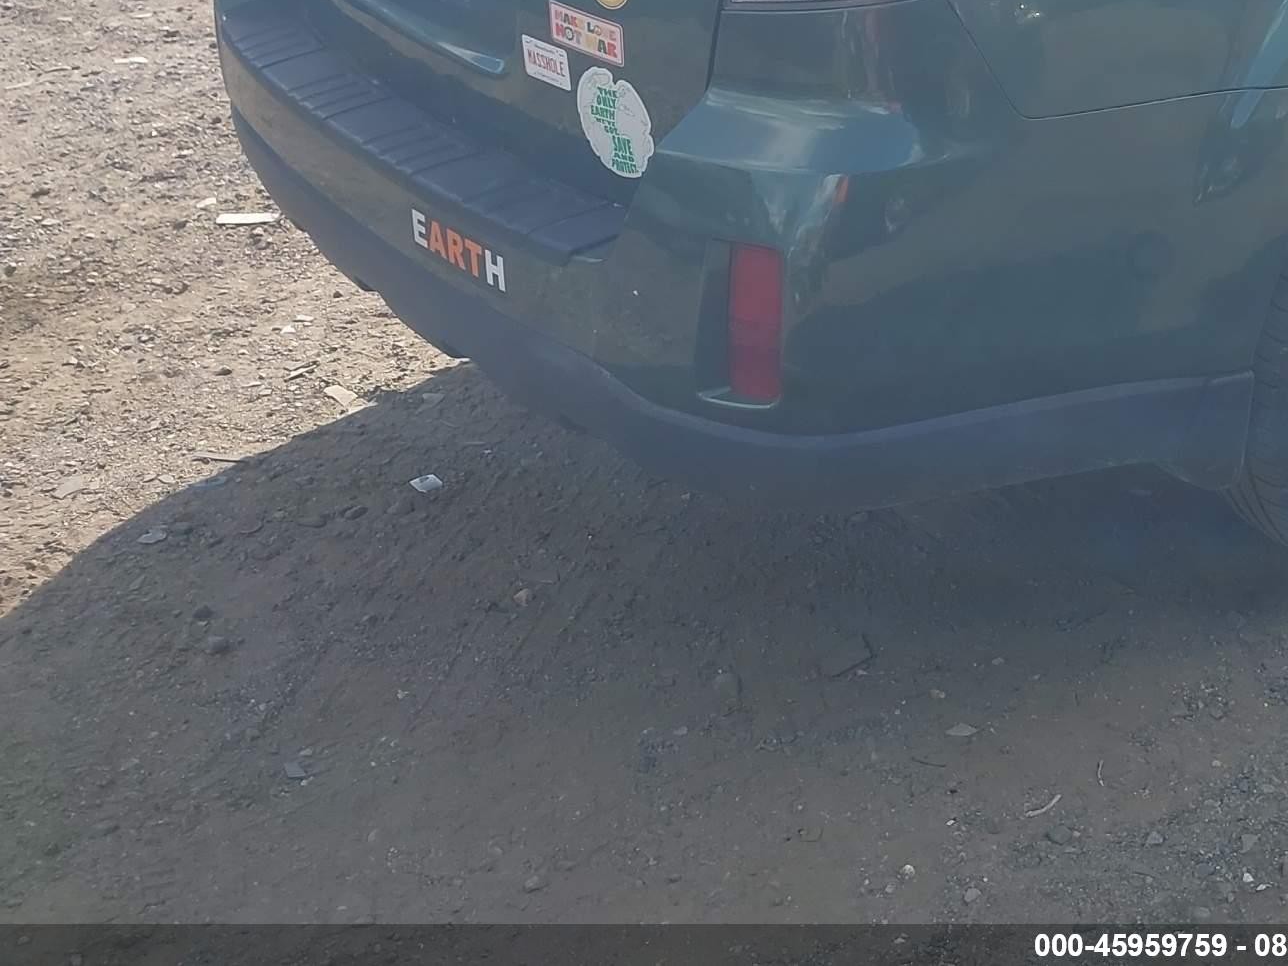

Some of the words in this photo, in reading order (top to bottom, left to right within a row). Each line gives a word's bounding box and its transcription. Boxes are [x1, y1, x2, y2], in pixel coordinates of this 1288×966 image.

[554, 9, 584, 29] MAKE
[555, 22, 582, 44] NOT
[585, 34, 618, 58] WAR
[527, 49, 566, 77] MASSHOLE
[597, 85, 617, 98] THE
[596, 95, 616, 109] ONLY
[590, 105, 616, 120] EARTH
[612, 135, 632, 155] SAVE
[613, 152, 634, 162] AND
[411, 208, 506, 293] EARTH
